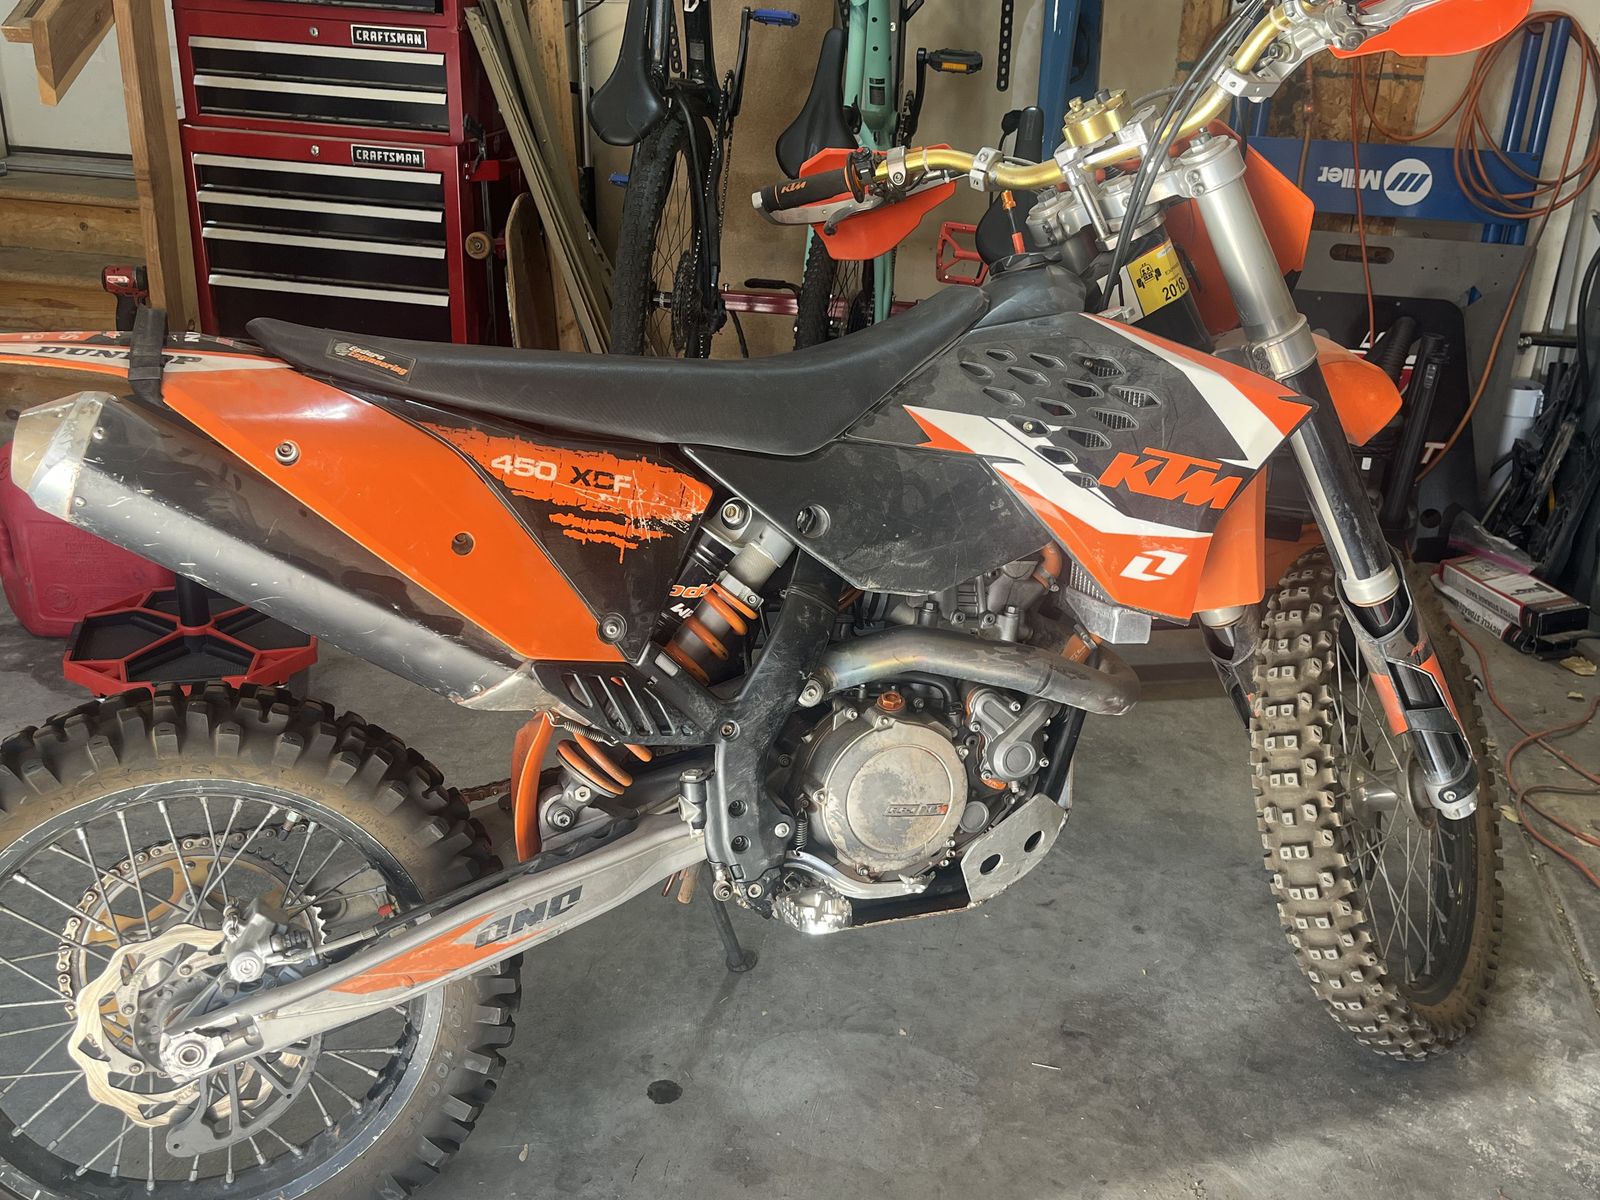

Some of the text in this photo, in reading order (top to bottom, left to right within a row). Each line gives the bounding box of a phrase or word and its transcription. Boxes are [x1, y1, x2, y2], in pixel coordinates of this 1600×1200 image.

[356, 30, 422, 45] CRAFTSMAN
[356, 149, 420, 165] CRAFTSMAN
[781, 181, 807, 193] KTM
[1317, 166, 1382, 190] Miller
[1162, 277, 1186, 302] 2018
[33, 346, 202, 365] DUNP
[490, 455, 632, 492] 450 XCF
[1097, 447, 1243, 509] KTM
